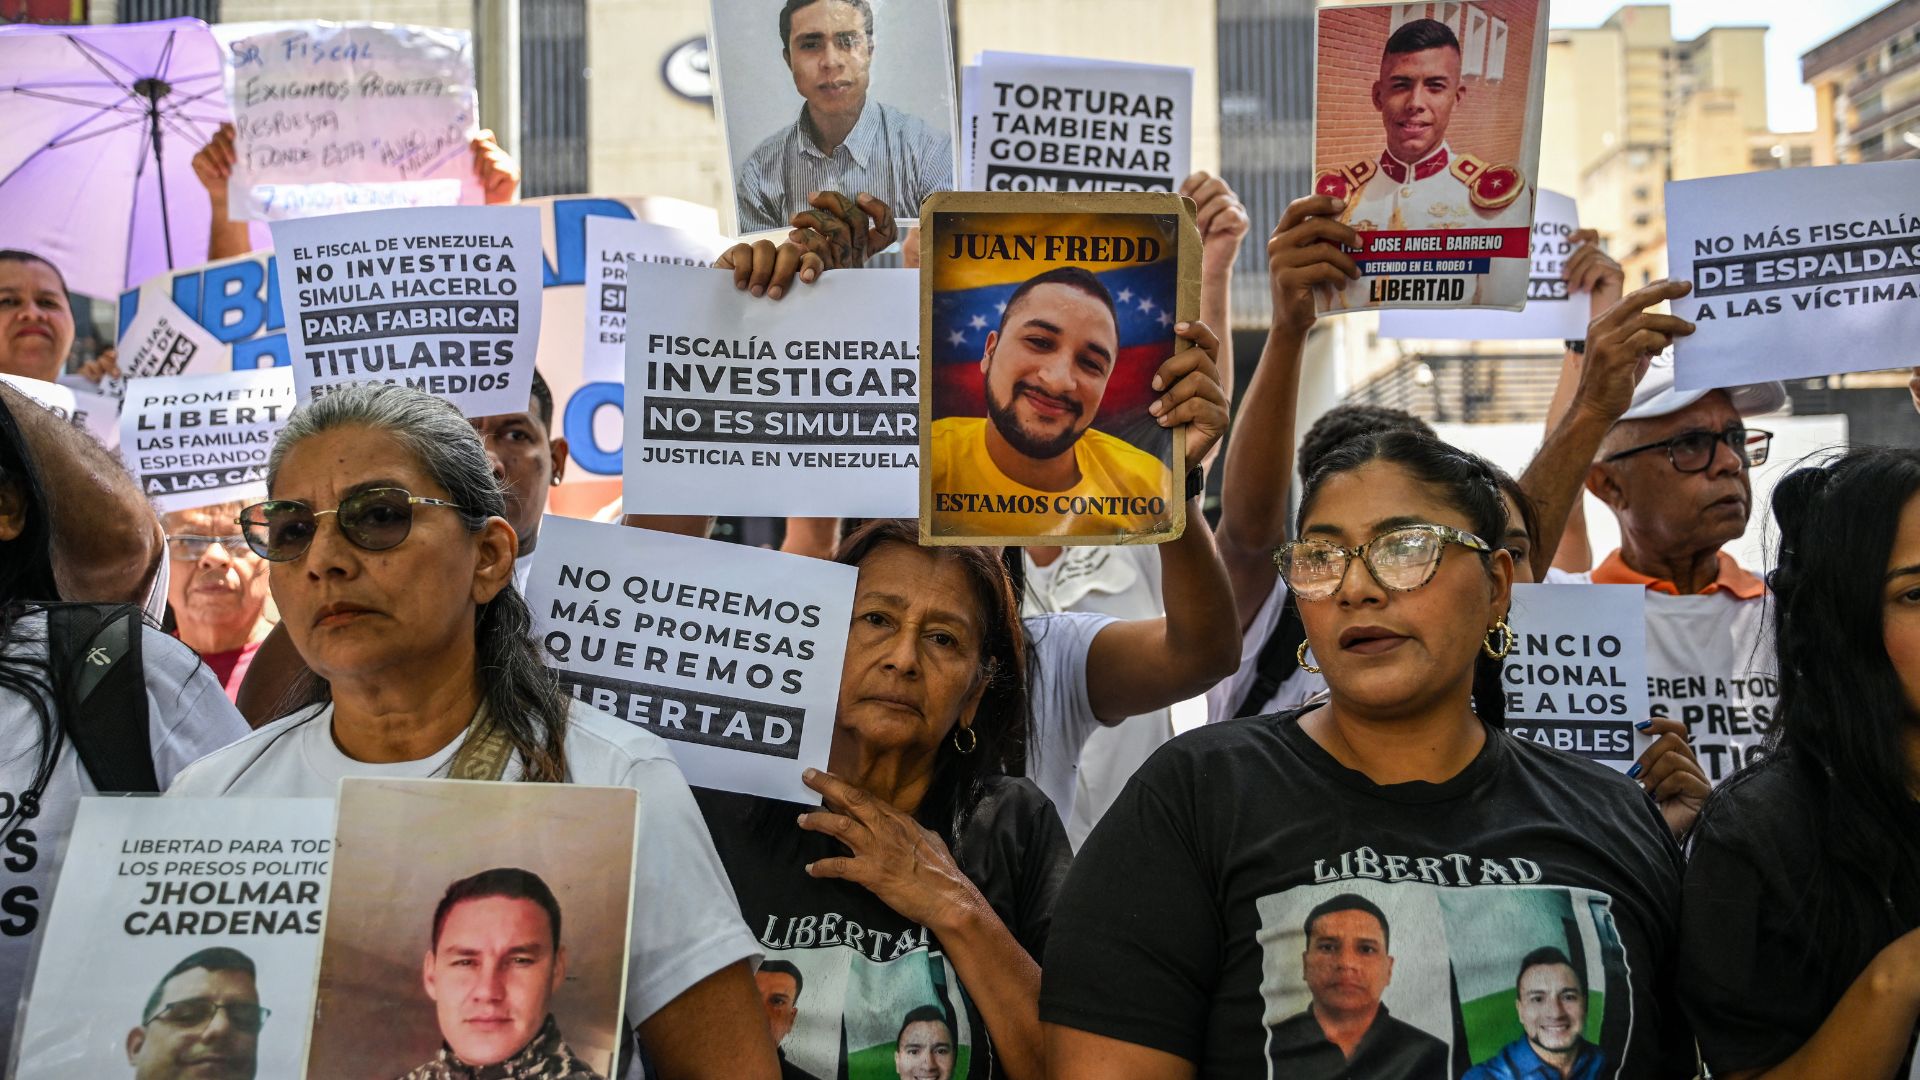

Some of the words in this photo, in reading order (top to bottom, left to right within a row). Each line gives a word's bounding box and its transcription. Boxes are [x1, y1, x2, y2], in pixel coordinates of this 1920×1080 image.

[246, 76, 351, 107] EXIGIMOS
[994, 82, 1174, 121] TORTURAR
[992, 112, 1128, 143] TAMBIEN
[1140, 124, 1172, 146] ES
[990, 139, 1170, 172] GOBERNAR
[293, 248, 312, 260] EL
[317, 241, 371, 258] FISCAL
[375, 238, 398, 251] DE
[403, 235, 514, 249] VENEZUELA
[948, 233, 1037, 261] JUAN
[1044, 235, 1160, 263] FREDD
[1370, 236, 1401, 253] JOSE
[1404, 236, 1442, 252] ANGEL
[1446, 235, 1503, 251] BARRENO
[1531, 243, 1571, 255] AD
[1695, 236, 1734, 256] NO
[1744, 225, 1800, 251] MÁS
[296, 264, 334, 285] NO
[347, 254, 516, 279] INVESTIGA
[602, 267, 627, 280] PR
[1365, 260, 1407, 273] DETENIDO
[1409, 260, 1422, 273] EN
[1423, 260, 1434, 272] EL
[1436, 260, 1464, 272] RODEO
[1467, 260, 1473, 271] 1
[1699, 263, 1744, 290] DE
[299, 282, 385, 307] SIMULA
[392, 277, 517, 298] HACERLO
[1369, 278, 1465, 302] LIBERTAD
[1696, 303, 1716, 321] A
[1726, 296, 1782, 318] LAS
[1792, 281, 1920, 311] VÍCTIMA
[304, 313, 370, 339] PARA
[377, 307, 516, 331] FABRICAR
[305, 339, 514, 377] TITULARES
[649, 334, 777, 360] FISCALÍA
[648, 361, 917, 397] INVESTIGAR
[137, 404, 284, 431] LIBERT
[650, 406, 701, 433] NO
[714, 409, 754, 434] ES
[764, 412, 917, 436] SIMULAR
[137, 436, 174, 451] LAS
[180, 430, 269, 449] FAMILIAS
[140, 449, 266, 471] ESPERANDO
[642, 447, 745, 466] JUSTICIA
[752, 451, 781, 467] EN
[787, 452, 919, 468] VENEZUELA
[147, 478, 166, 493] A
[171, 471, 220, 489] LAS
[935, 493, 1049, 515] ESTAMOS
[1053, 496, 1165, 516] CONTIGO
[558, 564, 611, 593] NO
[623, 575, 822, 628] QUEREMOS
[550, 599, 621, 629] MÁS
[633, 612, 815, 661] PROMESAS
[544, 630, 803, 695] QUEREMOS
[1715, 678, 1727, 699] A
[572, 684, 793, 745] IBERTAD
[1535, 692, 1558, 713] A
[1568, 693, 1628, 715] LOS
[121, 839, 223, 854] LIBERTAD
[228, 839, 284, 854] PARA
[118, 861, 159, 876] LOS
[164, 861, 247, 876] PRESOS
[1313, 846, 1542, 887] LIBERTAD
[140, 880, 320, 905] JHOLMAR
[124, 910, 322, 936] CARDENAS
